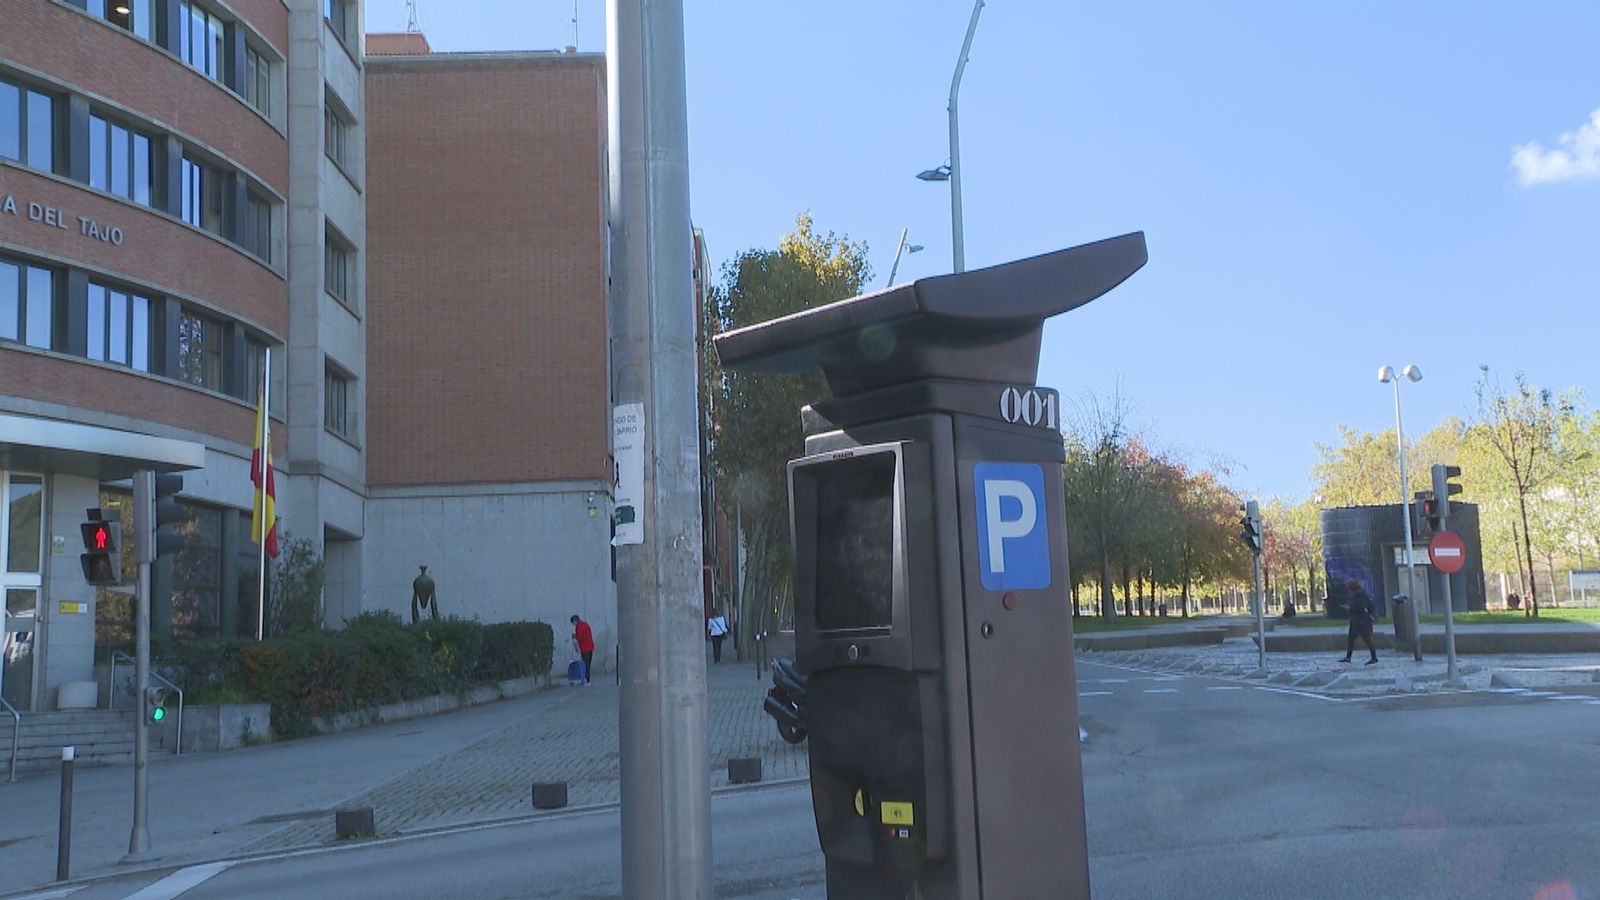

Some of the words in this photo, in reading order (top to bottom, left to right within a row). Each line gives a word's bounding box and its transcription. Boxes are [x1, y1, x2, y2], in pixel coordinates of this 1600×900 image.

[0, 195, 17, 215] A
[28, 201, 68, 230] DEL
[77, 216, 123, 246] TAJO
[1000, 387, 1056, 430] 001
[984, 479, 1037, 573] P
